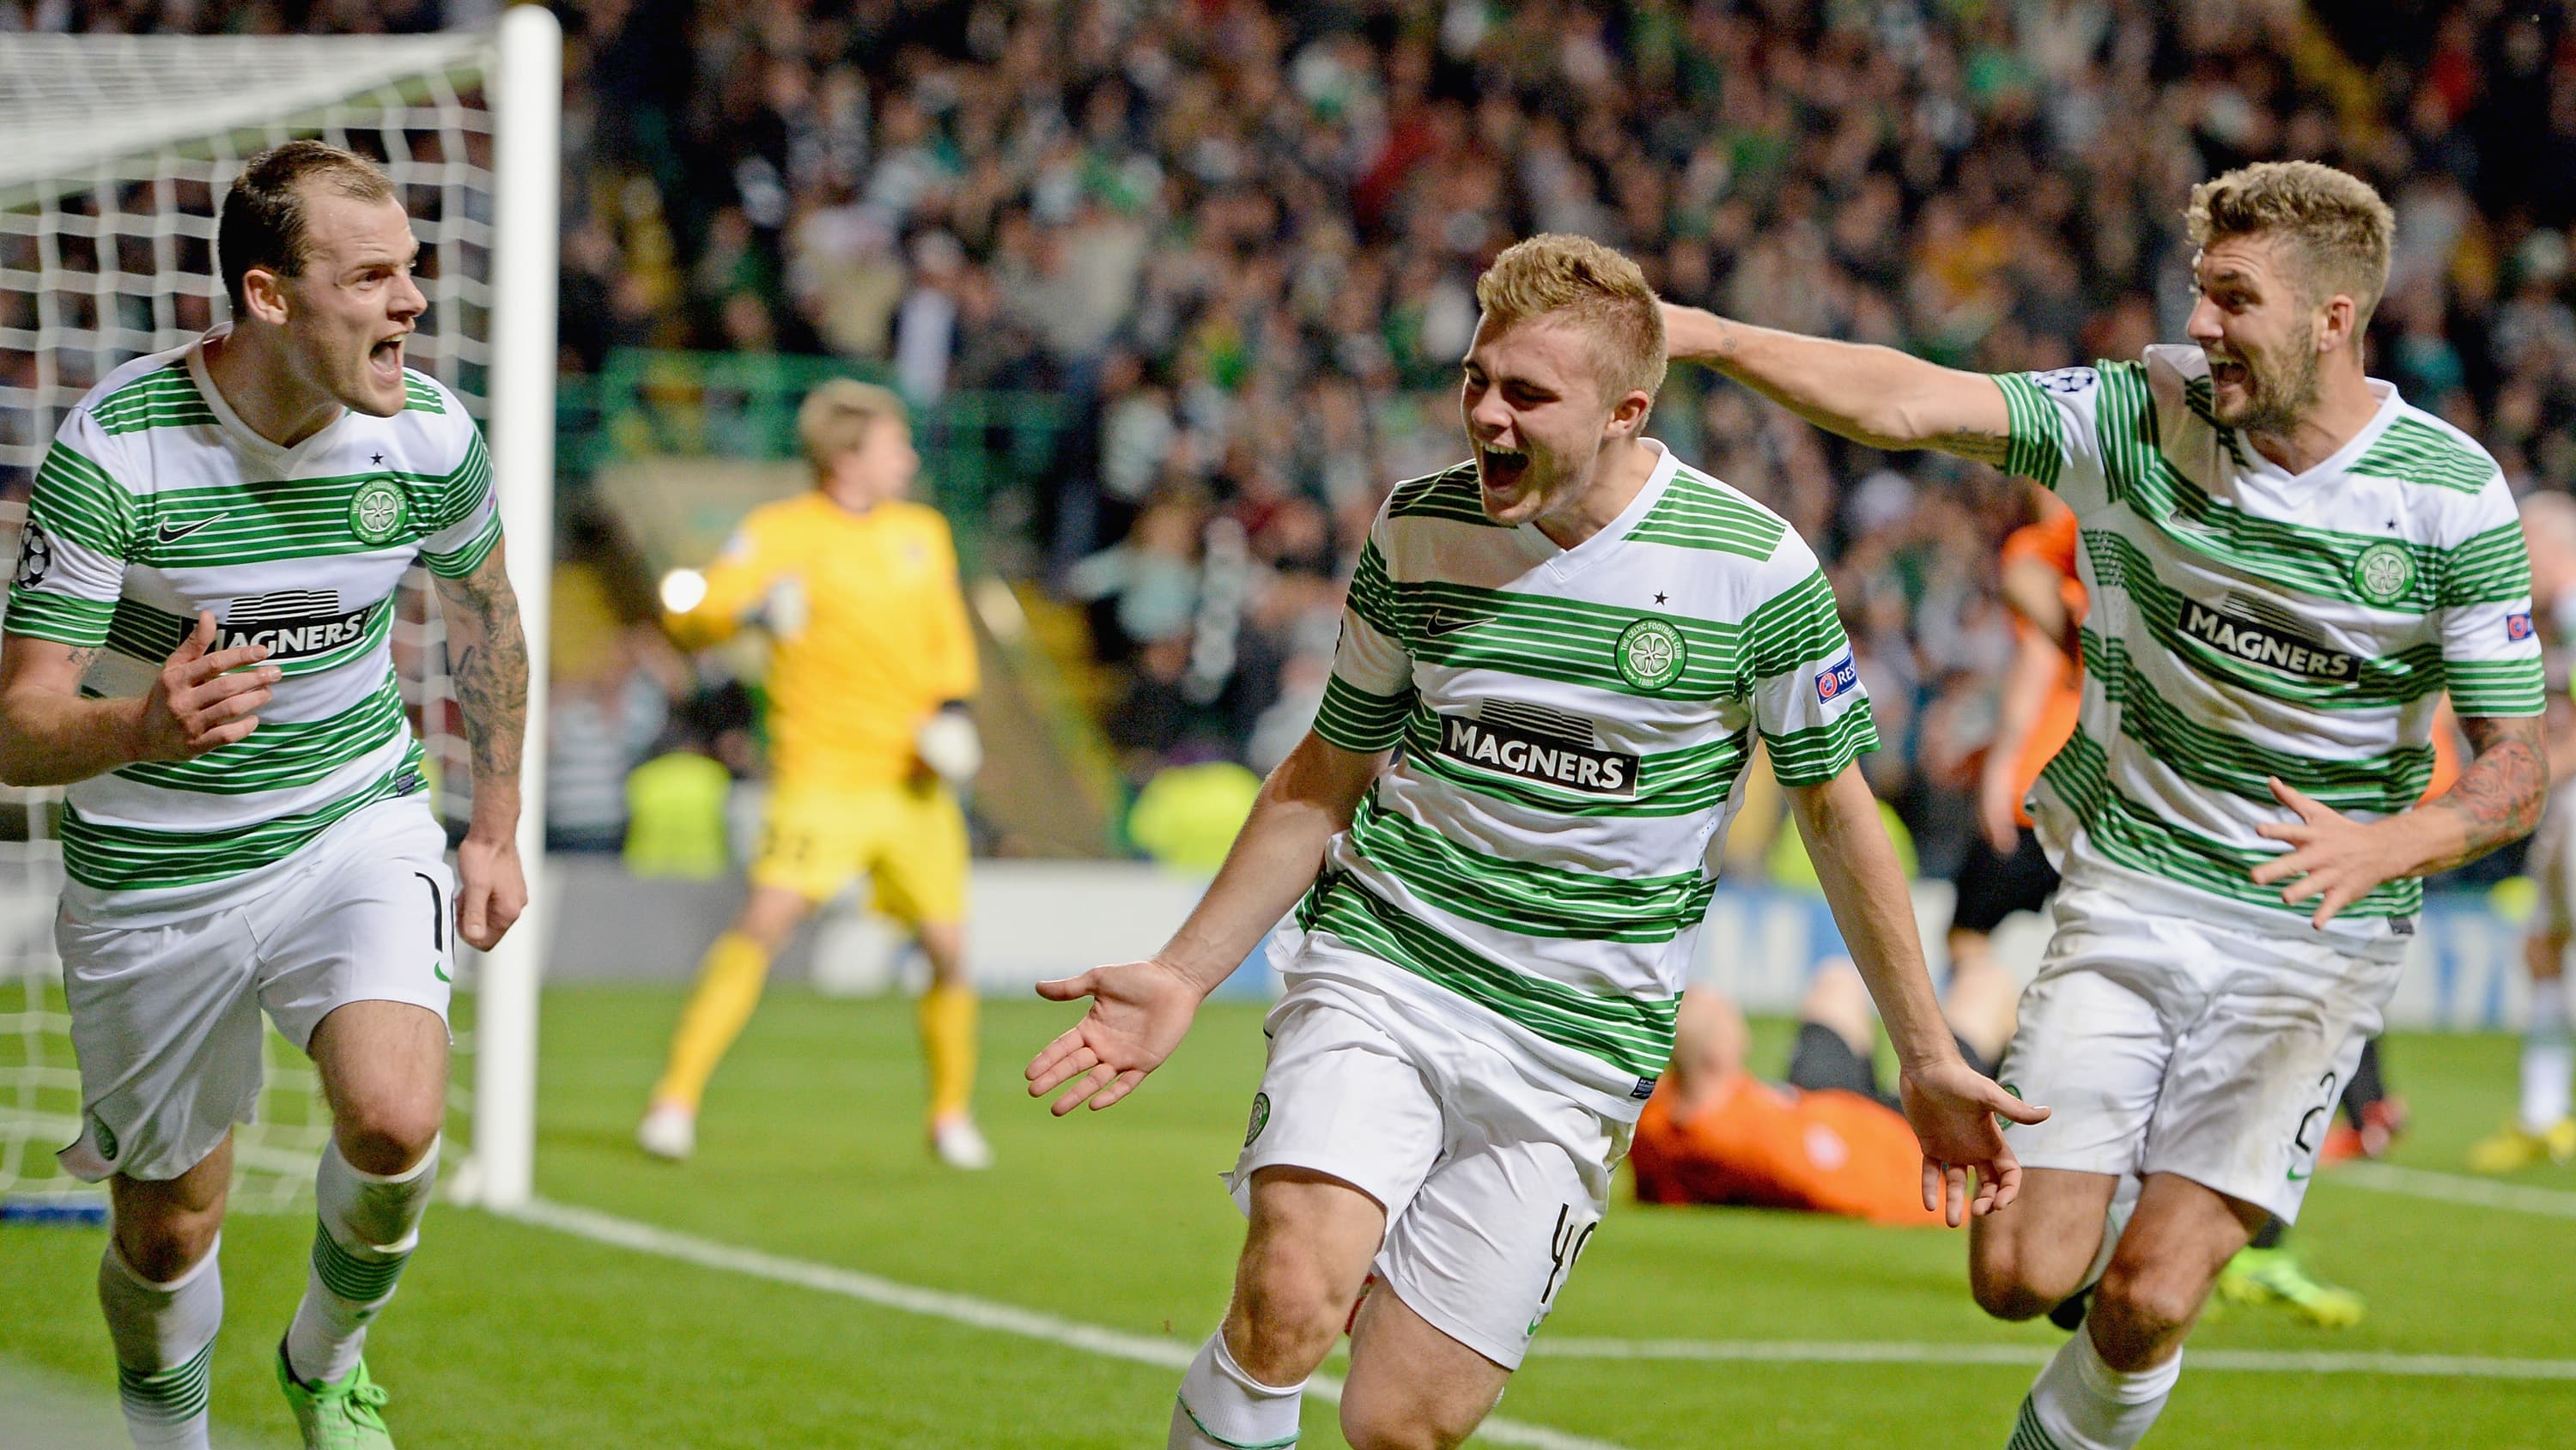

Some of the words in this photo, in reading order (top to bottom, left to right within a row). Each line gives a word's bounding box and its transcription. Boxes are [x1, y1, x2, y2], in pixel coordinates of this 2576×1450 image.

[1620, 638, 1631, 651] THE
[1627, 623, 1648, 639] CELTIC
[1648, 622, 1677, 642] FOOTBALL
[1674, 641, 1682, 660] CLUB
[2187, 604, 2351, 677] MAGNERS
[1450, 719, 1624, 789] MAGNERS
[414, 871, 455, 962] 1
